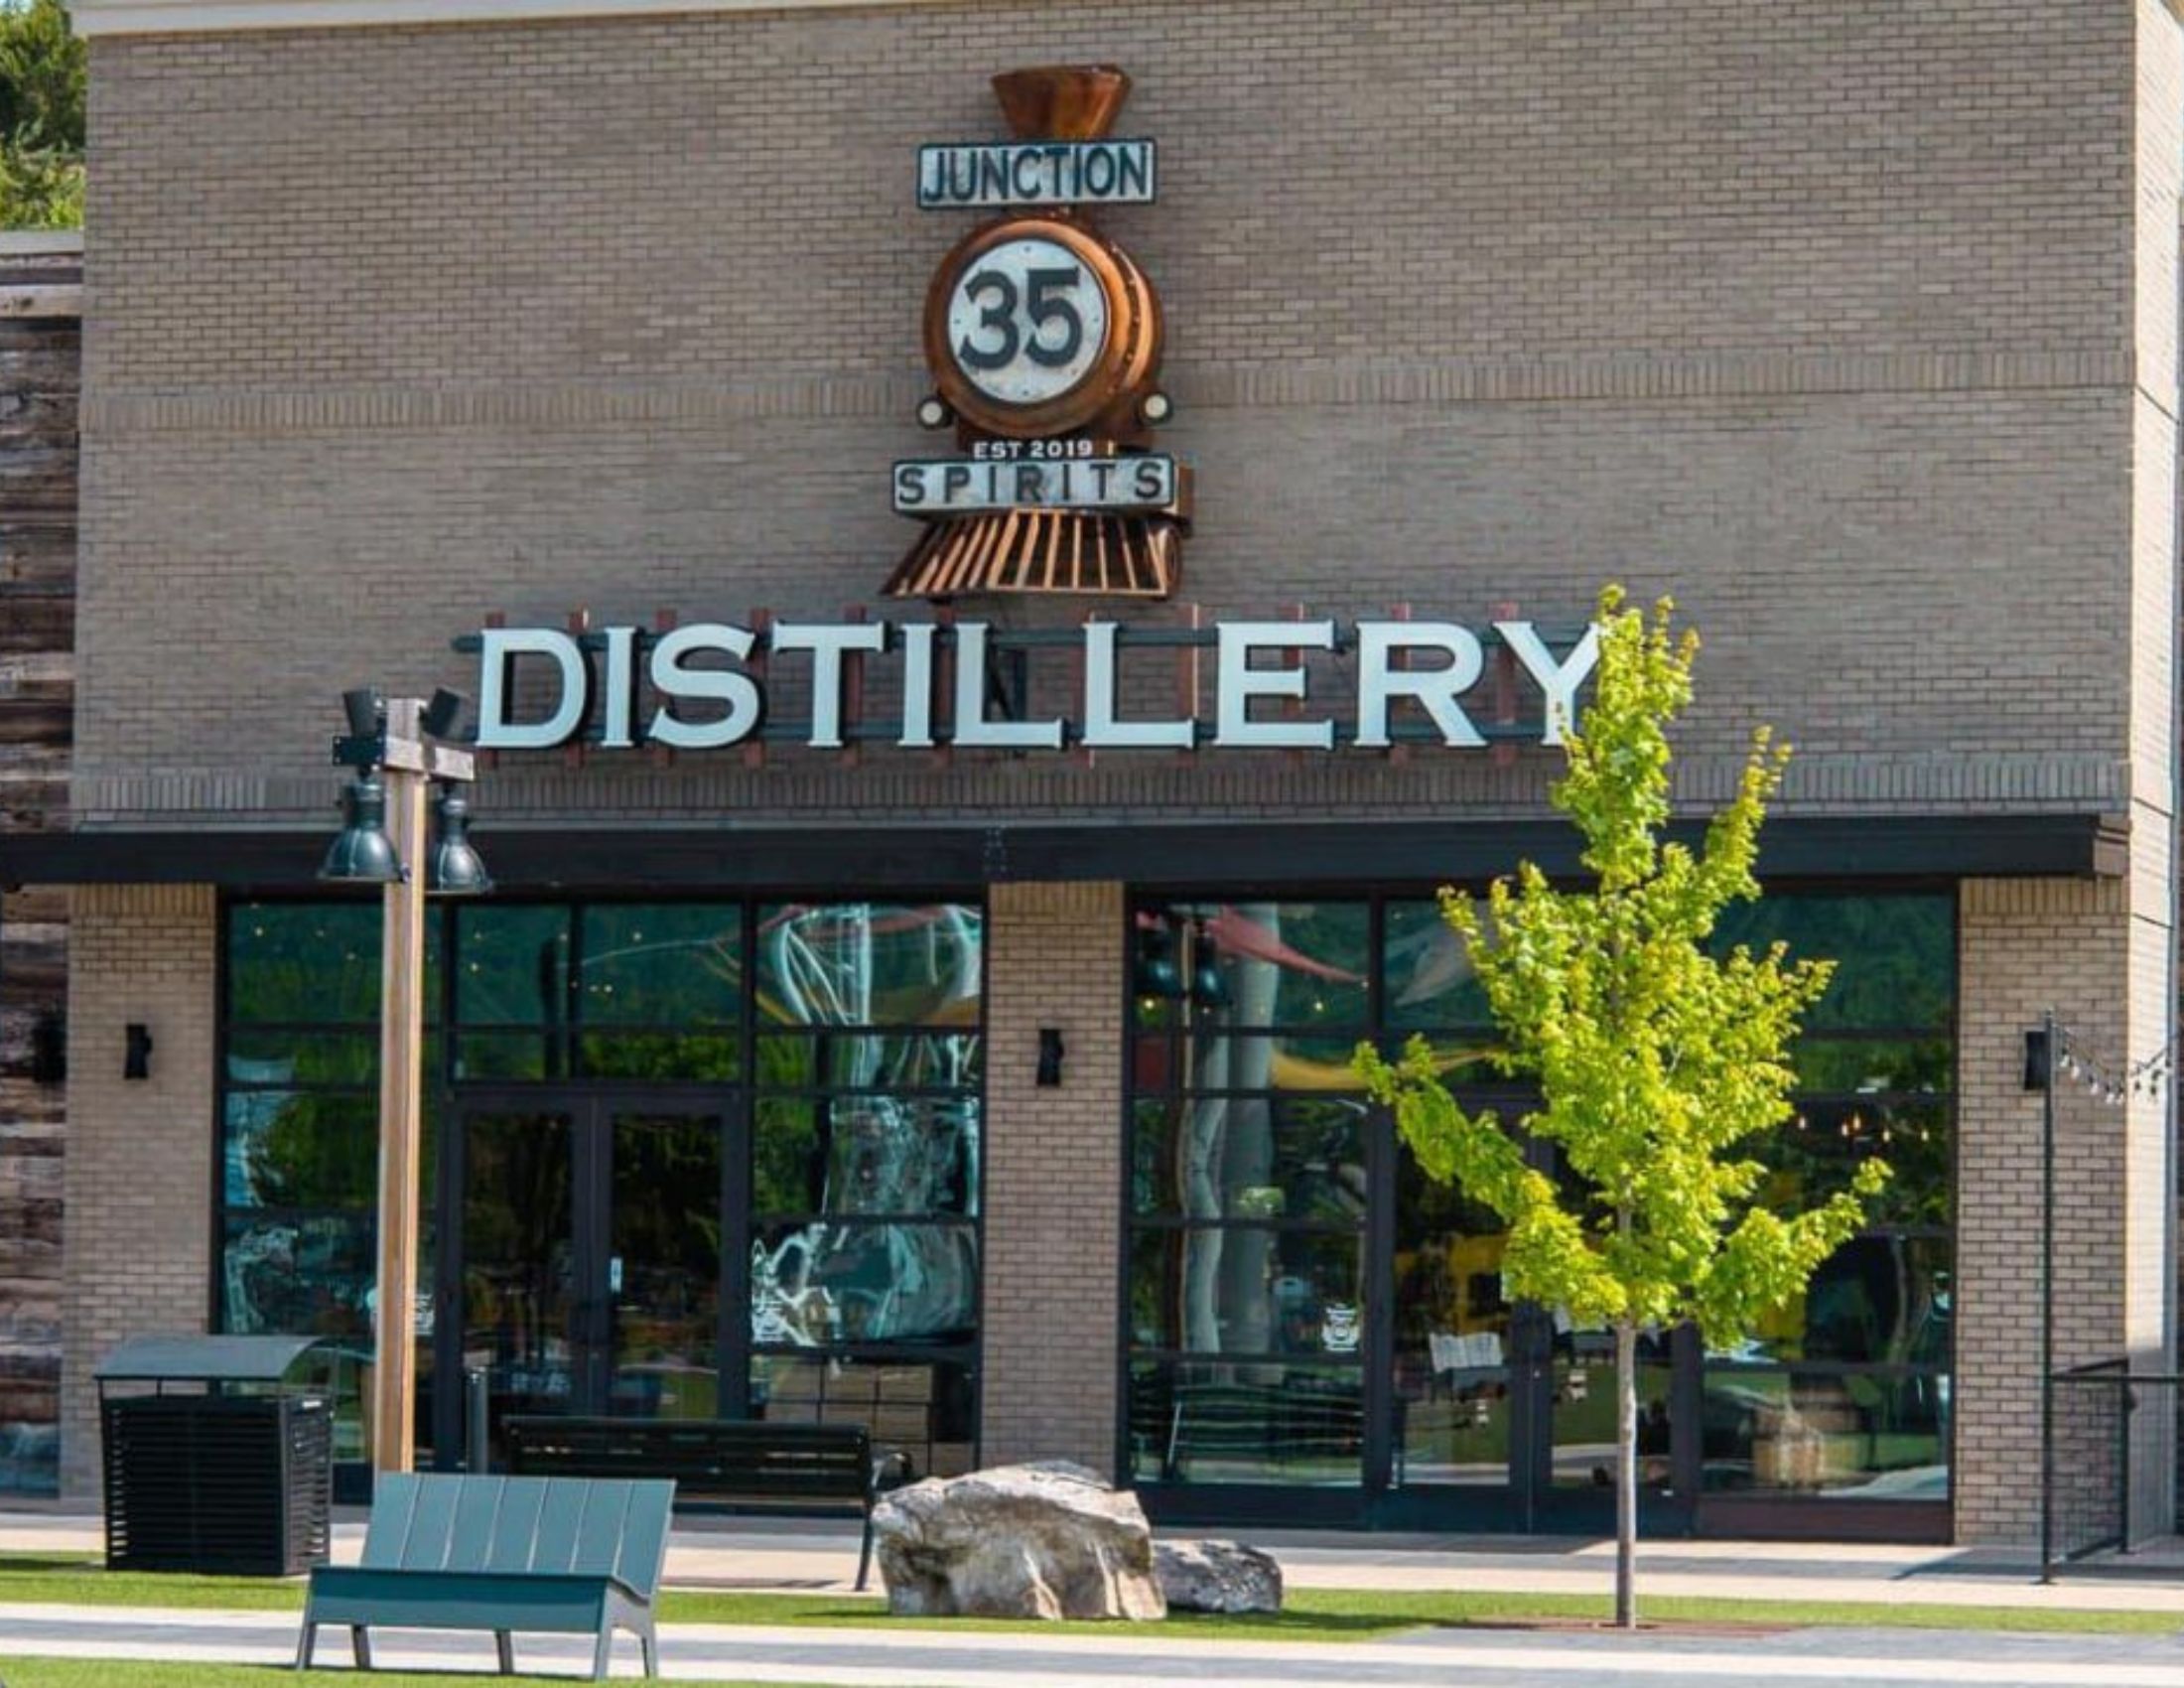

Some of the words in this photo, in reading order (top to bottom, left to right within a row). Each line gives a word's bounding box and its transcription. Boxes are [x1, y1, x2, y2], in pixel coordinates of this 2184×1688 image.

[923, 144, 1148, 202] JUNCTION
[959, 265, 1083, 370] 35
[973, 441, 1022, 460] EST
[1030, 439, 1093, 458] 2019
[897, 462, 1162, 504] SPIRITS
[476, 621, 1601, 749] DISTILLERY
